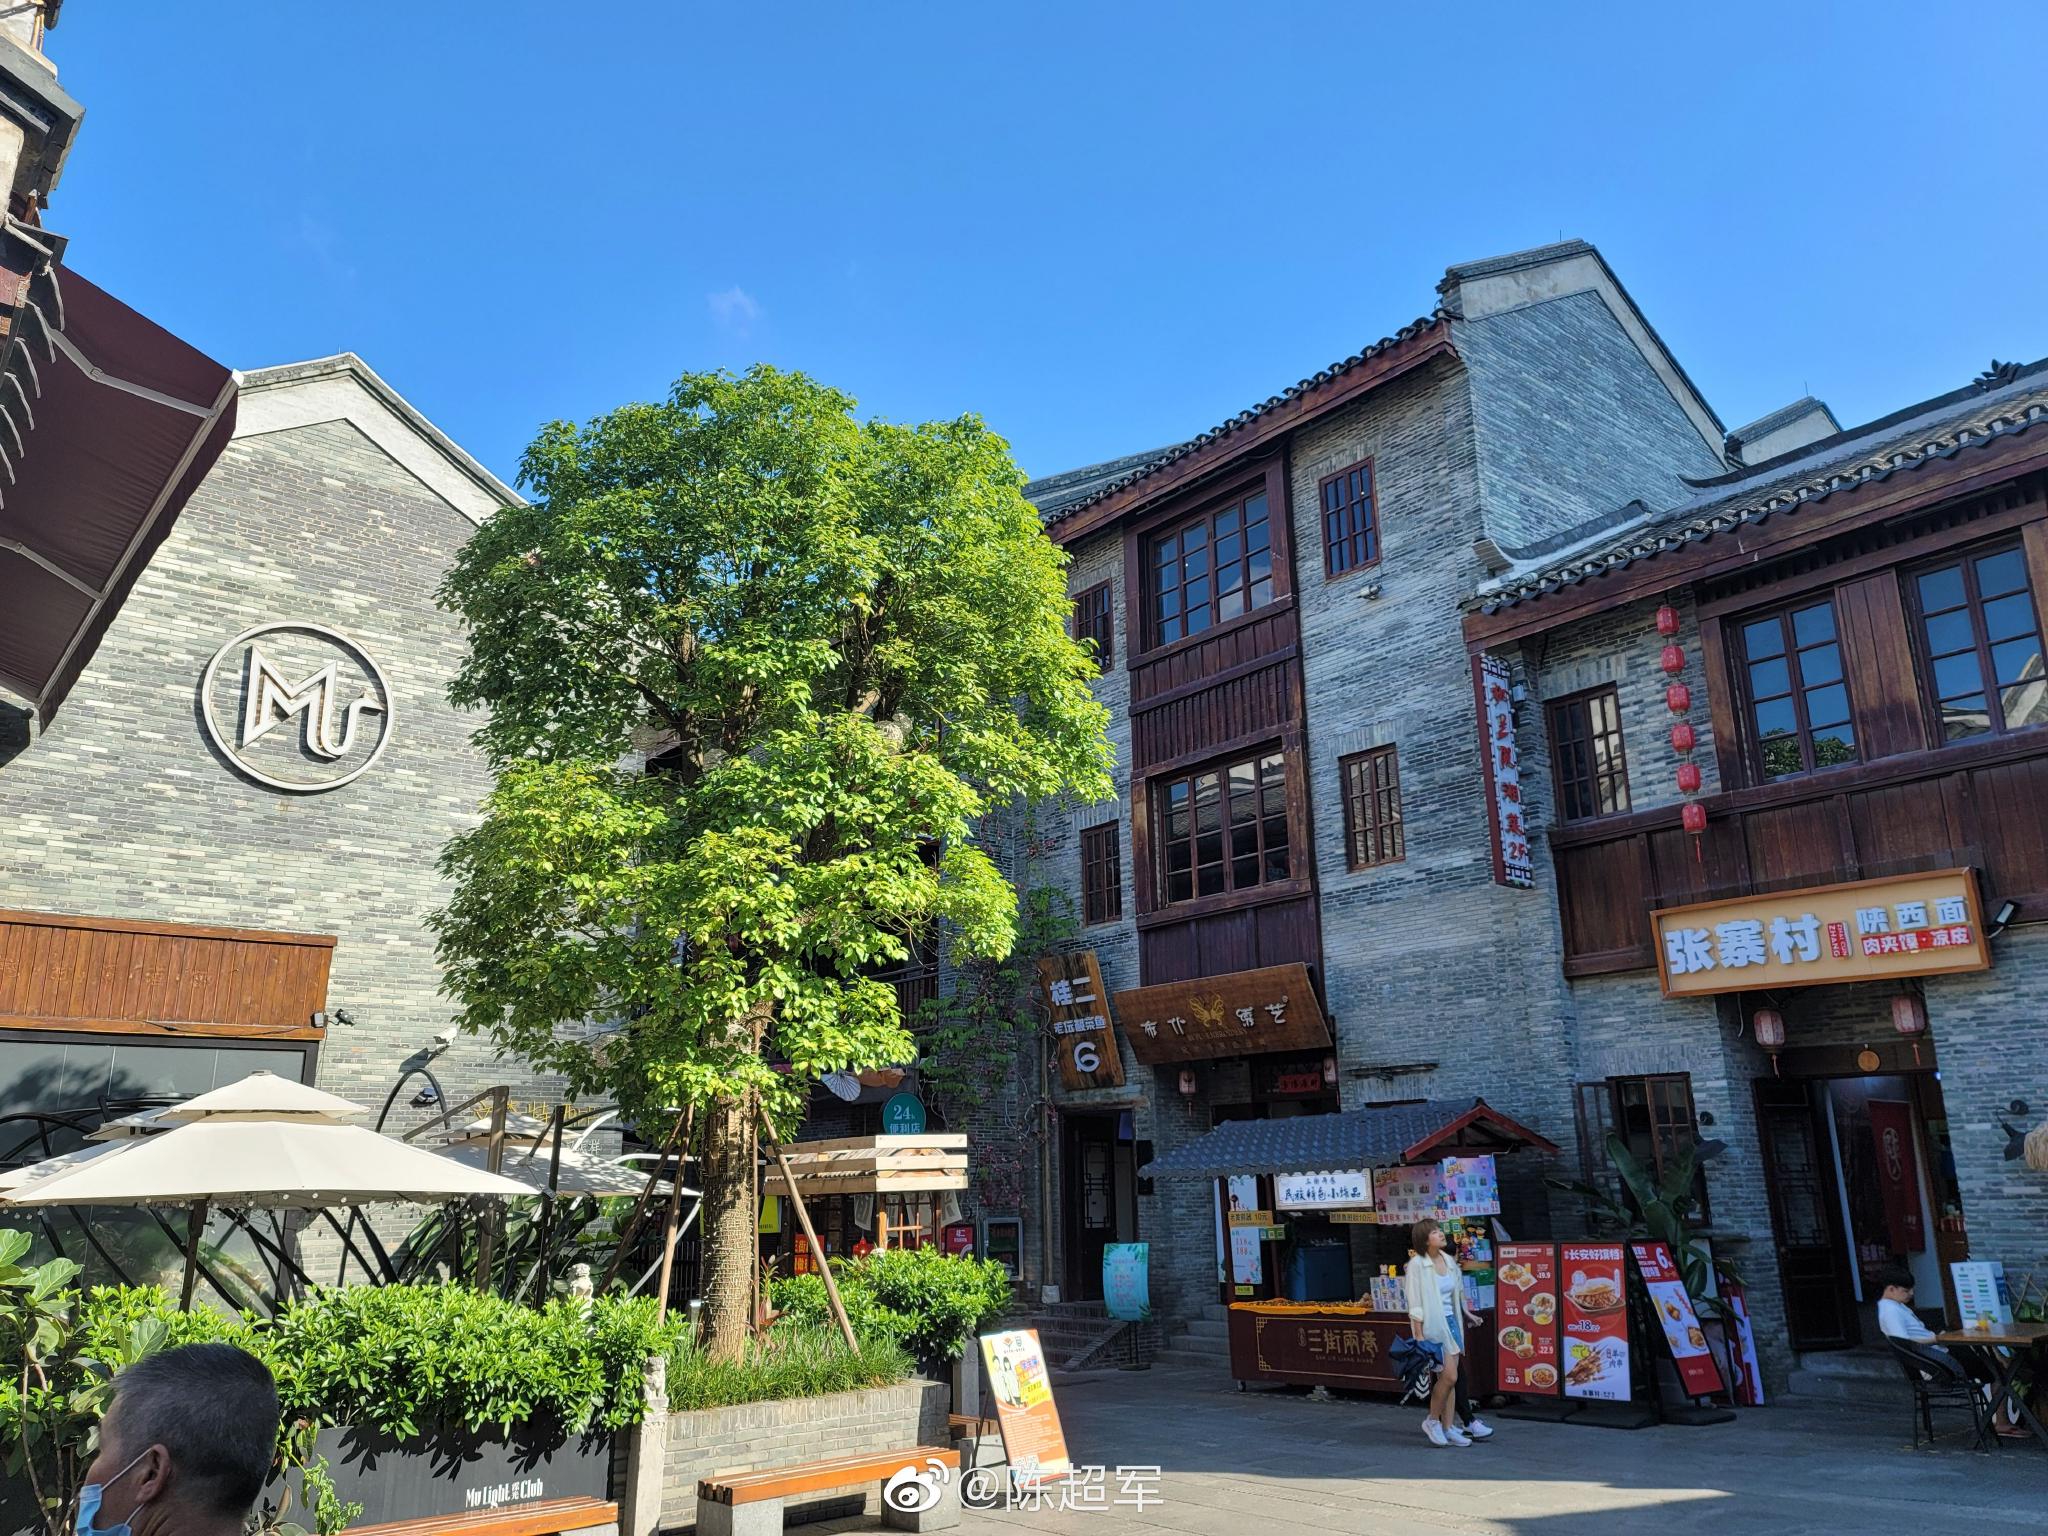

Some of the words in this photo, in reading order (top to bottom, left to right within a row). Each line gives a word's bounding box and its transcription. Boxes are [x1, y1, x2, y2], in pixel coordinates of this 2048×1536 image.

[1855, 895, 1968, 935] 陕西面
[1664, 912, 1822, 976] 张寨村
[1050, 976, 1096, 1006] 桂二
[889, 1122, 920, 1135] 便利店
[483, 1483, 510, 1509] Light
[520, 1478, 544, 1499] Club
